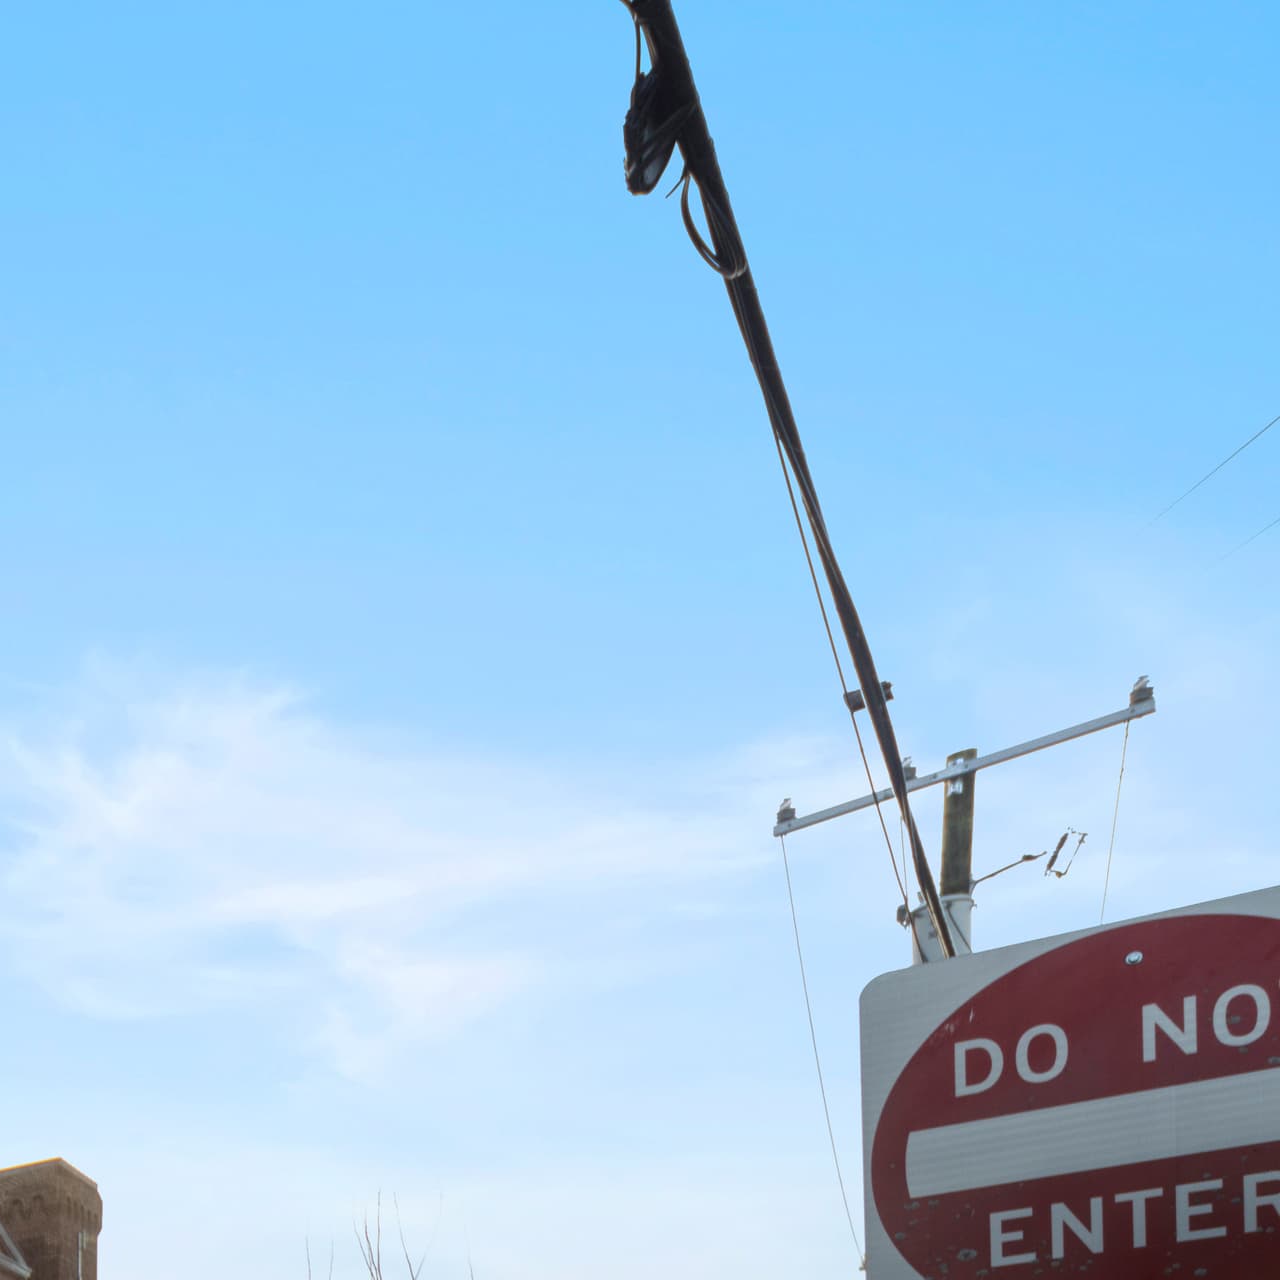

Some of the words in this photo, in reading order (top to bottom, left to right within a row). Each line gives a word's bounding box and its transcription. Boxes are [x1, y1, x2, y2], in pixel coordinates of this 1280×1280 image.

[954, 1023, 1069, 1098] DO
[1142, 984, 1280, 1063] NO
[989, 1170, 1280, 1268] ENTER
